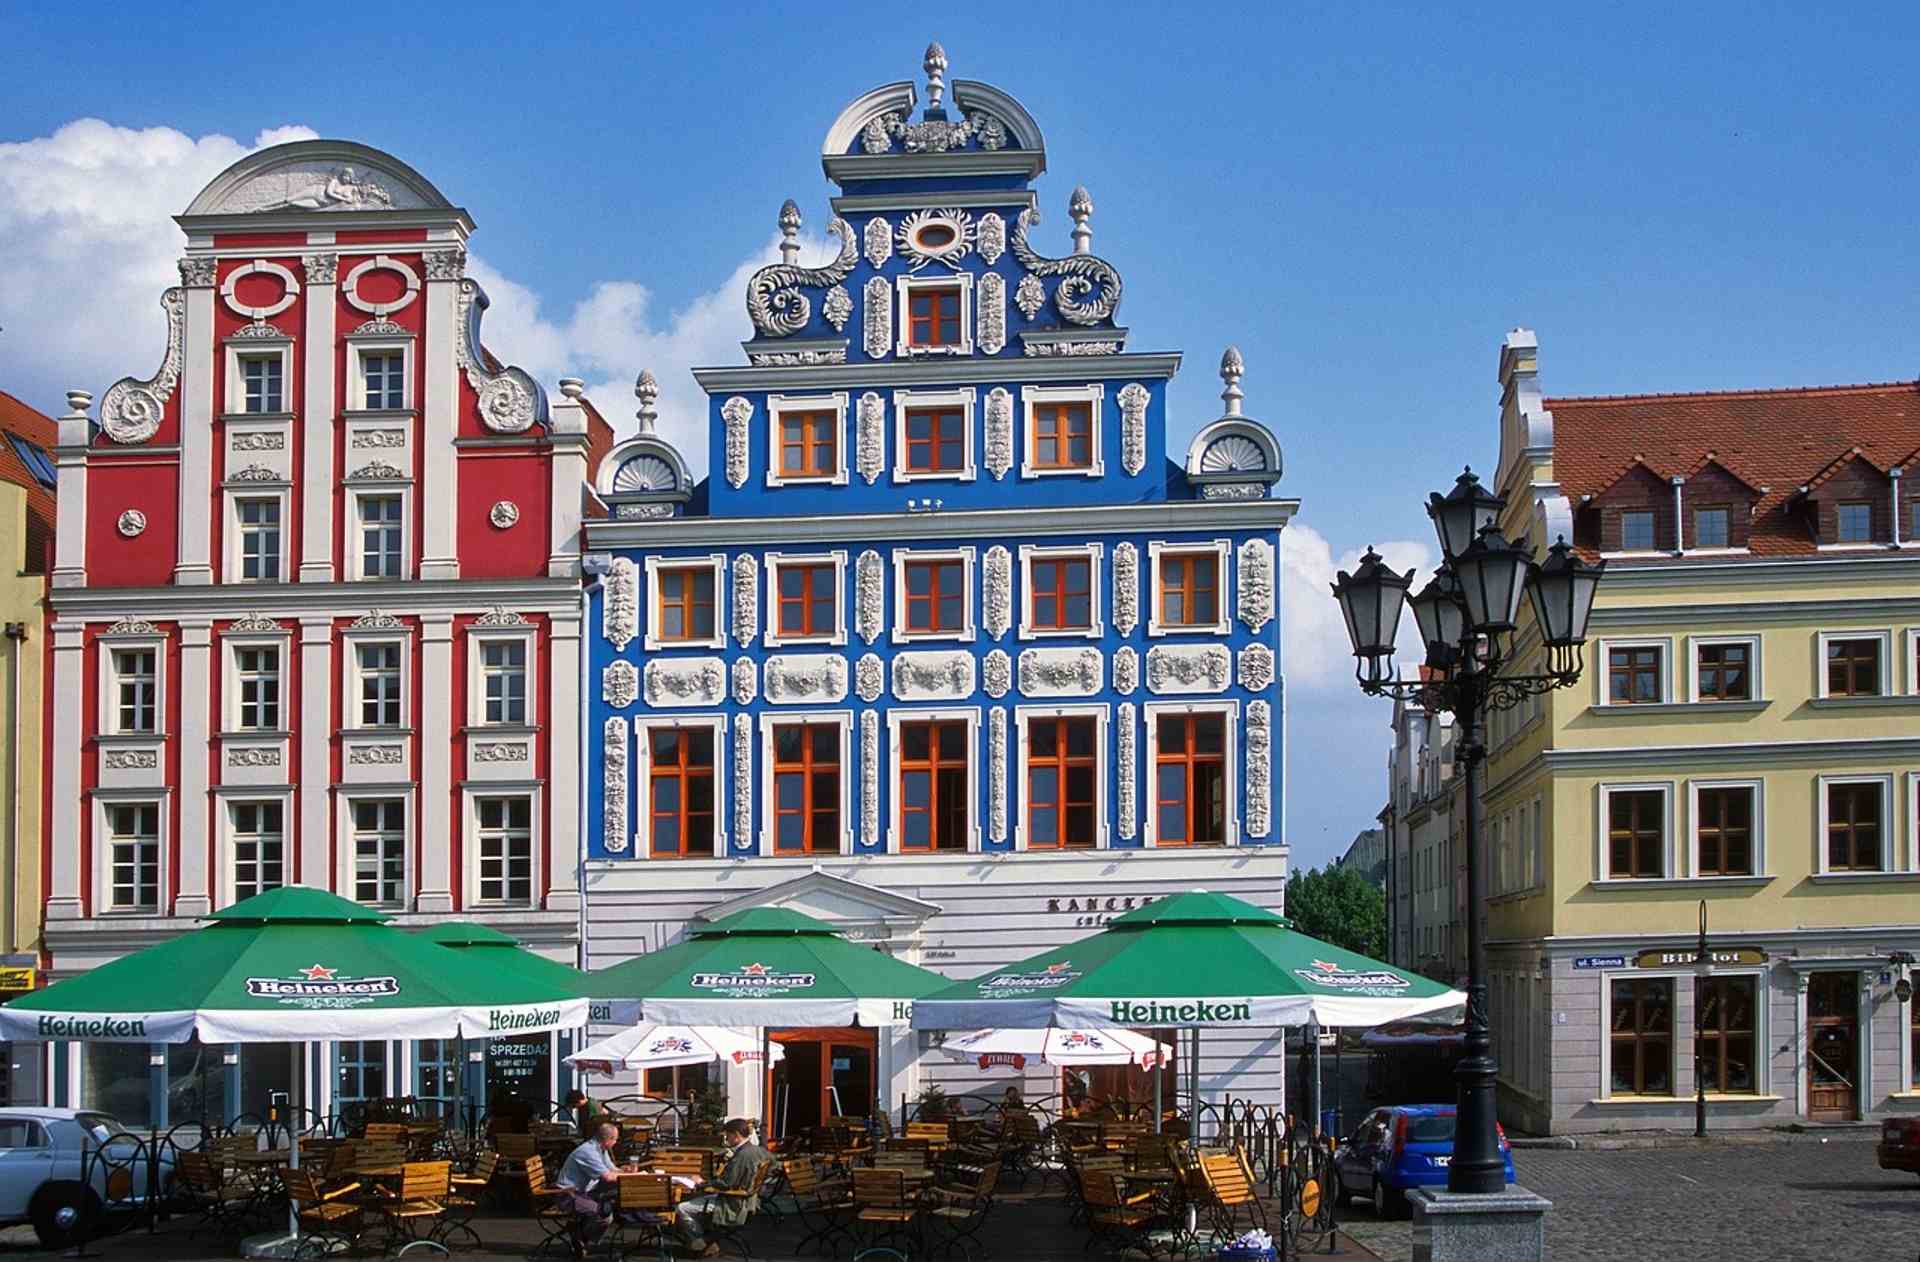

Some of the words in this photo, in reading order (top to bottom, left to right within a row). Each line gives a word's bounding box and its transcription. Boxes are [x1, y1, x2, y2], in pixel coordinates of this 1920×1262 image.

[1047, 897, 1154, 911] KANCLE
[1591, 957, 1622, 967] Sienna
[1662, 952, 1739, 963] Biblot
[259, 981, 388, 994] Heineken
[703, 976, 806, 986] Heineken
[1111, 1000, 1251, 1023] Heineken
[488, 1007, 560, 1031] Heineken
[38, 1015, 147, 1037] Heineken
